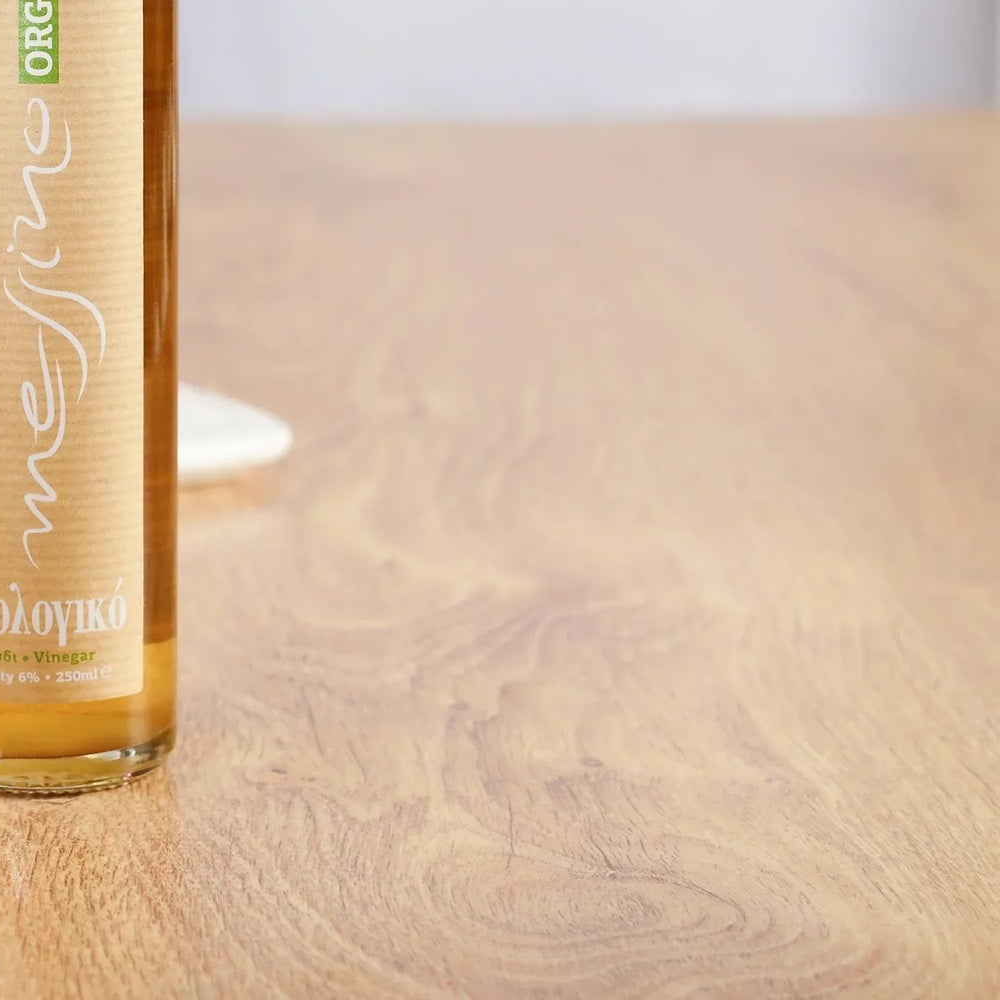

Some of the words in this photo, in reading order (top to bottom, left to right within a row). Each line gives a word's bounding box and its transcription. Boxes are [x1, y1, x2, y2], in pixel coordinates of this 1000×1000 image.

[4, 97, 106, 570] messino
[33, 651, 96, 665] Vinegar
[18, 671, 40, 683] 6%
[56, 668, 97, 682] 250ml
